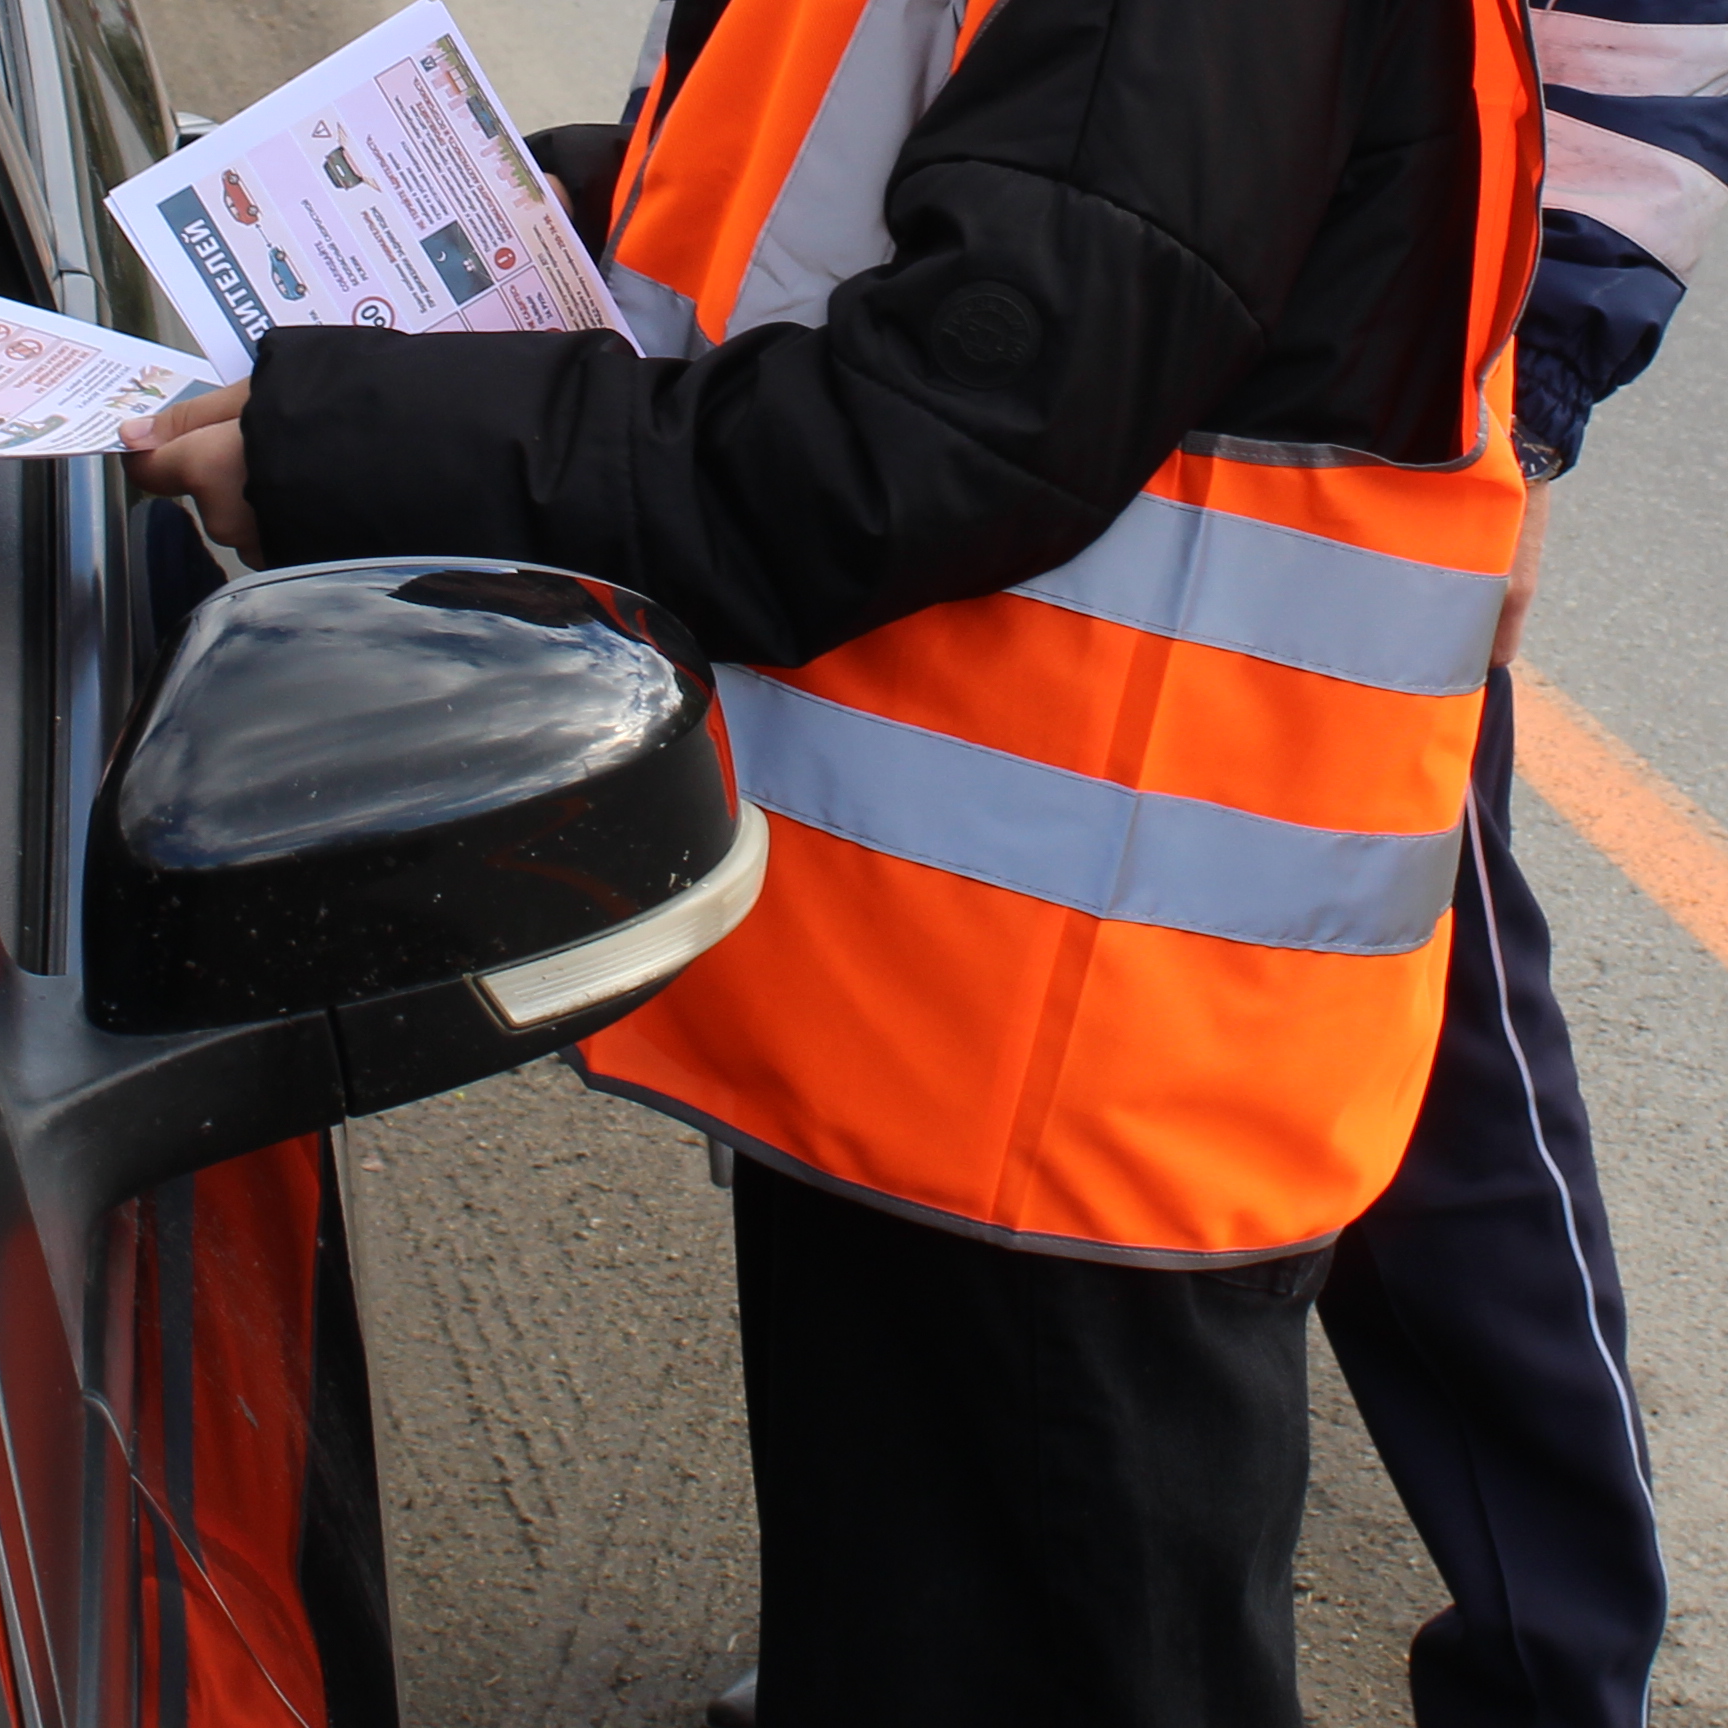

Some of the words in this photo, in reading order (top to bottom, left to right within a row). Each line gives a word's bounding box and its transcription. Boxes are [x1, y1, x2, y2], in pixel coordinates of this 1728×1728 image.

[299, 197, 332, 243] СКОРОСТНОЙ
[359, 209, 397, 264] ВНИМАТЕЛЬНЫ
[312, 239, 350, 293] СОБЛЮДАЙТЕ
[326, 241, 359, 287] БЕЗОПАСНЫЙ
[348, 254, 369, 281] РЕЖИМ
[507, 283, 531, 321] САДИТЕСЬ
